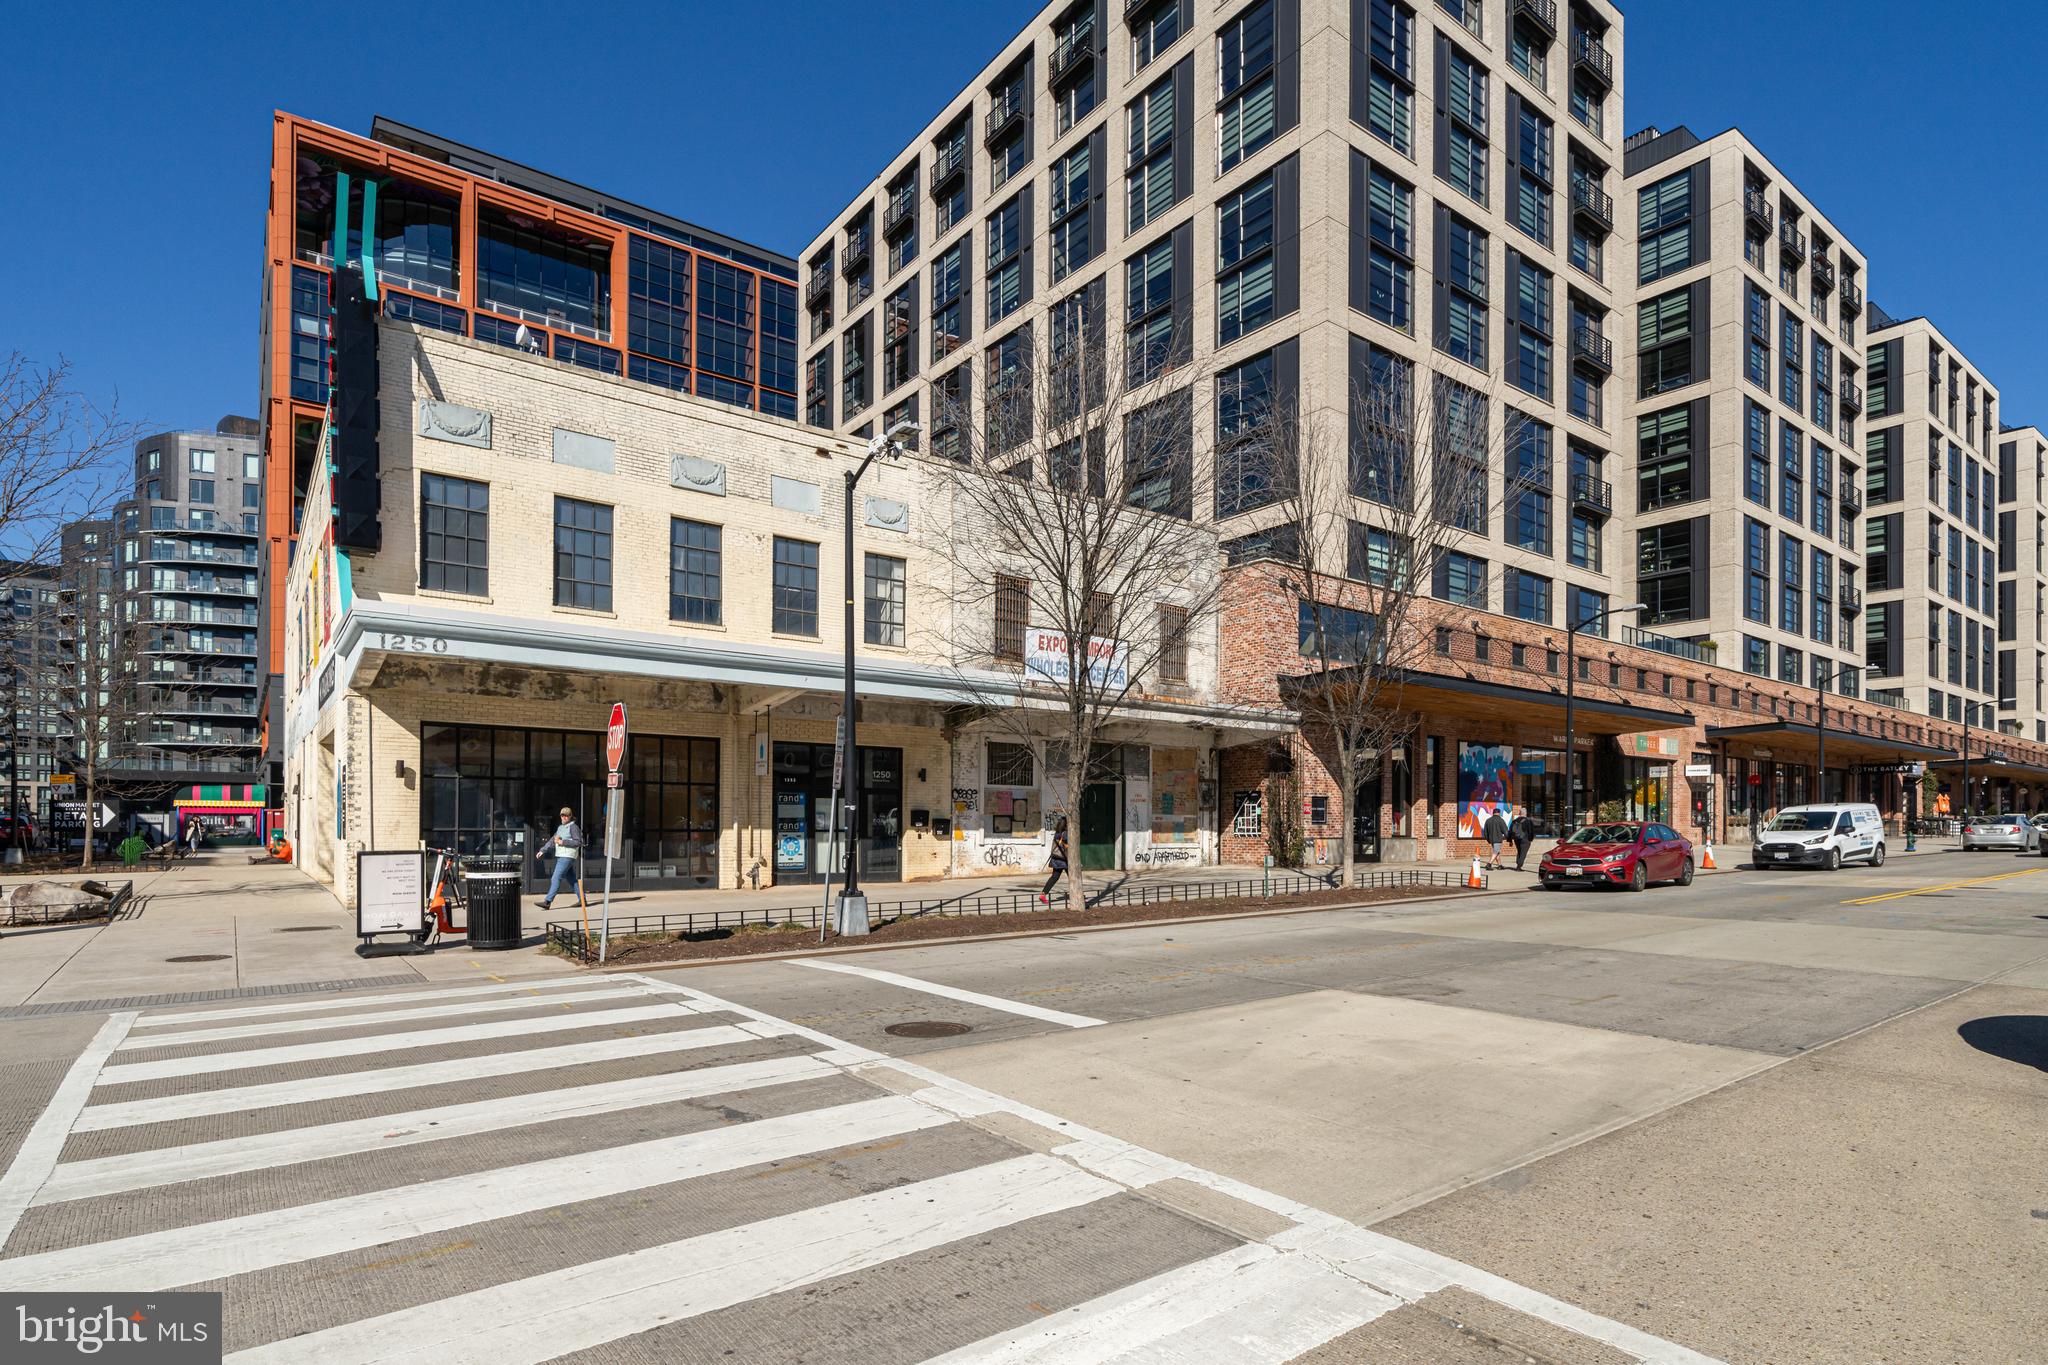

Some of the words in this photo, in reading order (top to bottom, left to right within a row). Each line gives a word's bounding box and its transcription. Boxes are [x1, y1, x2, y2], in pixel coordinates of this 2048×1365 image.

[378, 634, 448, 653] 1250
[607, 724, 624, 750] STOP
[872, 770, 891, 779] 1250
[778, 793, 800, 802] rand
[54, 811, 101, 821] RETAL
[54, 820, 101, 828] PARKIG
[778, 821, 800, 830] rand
